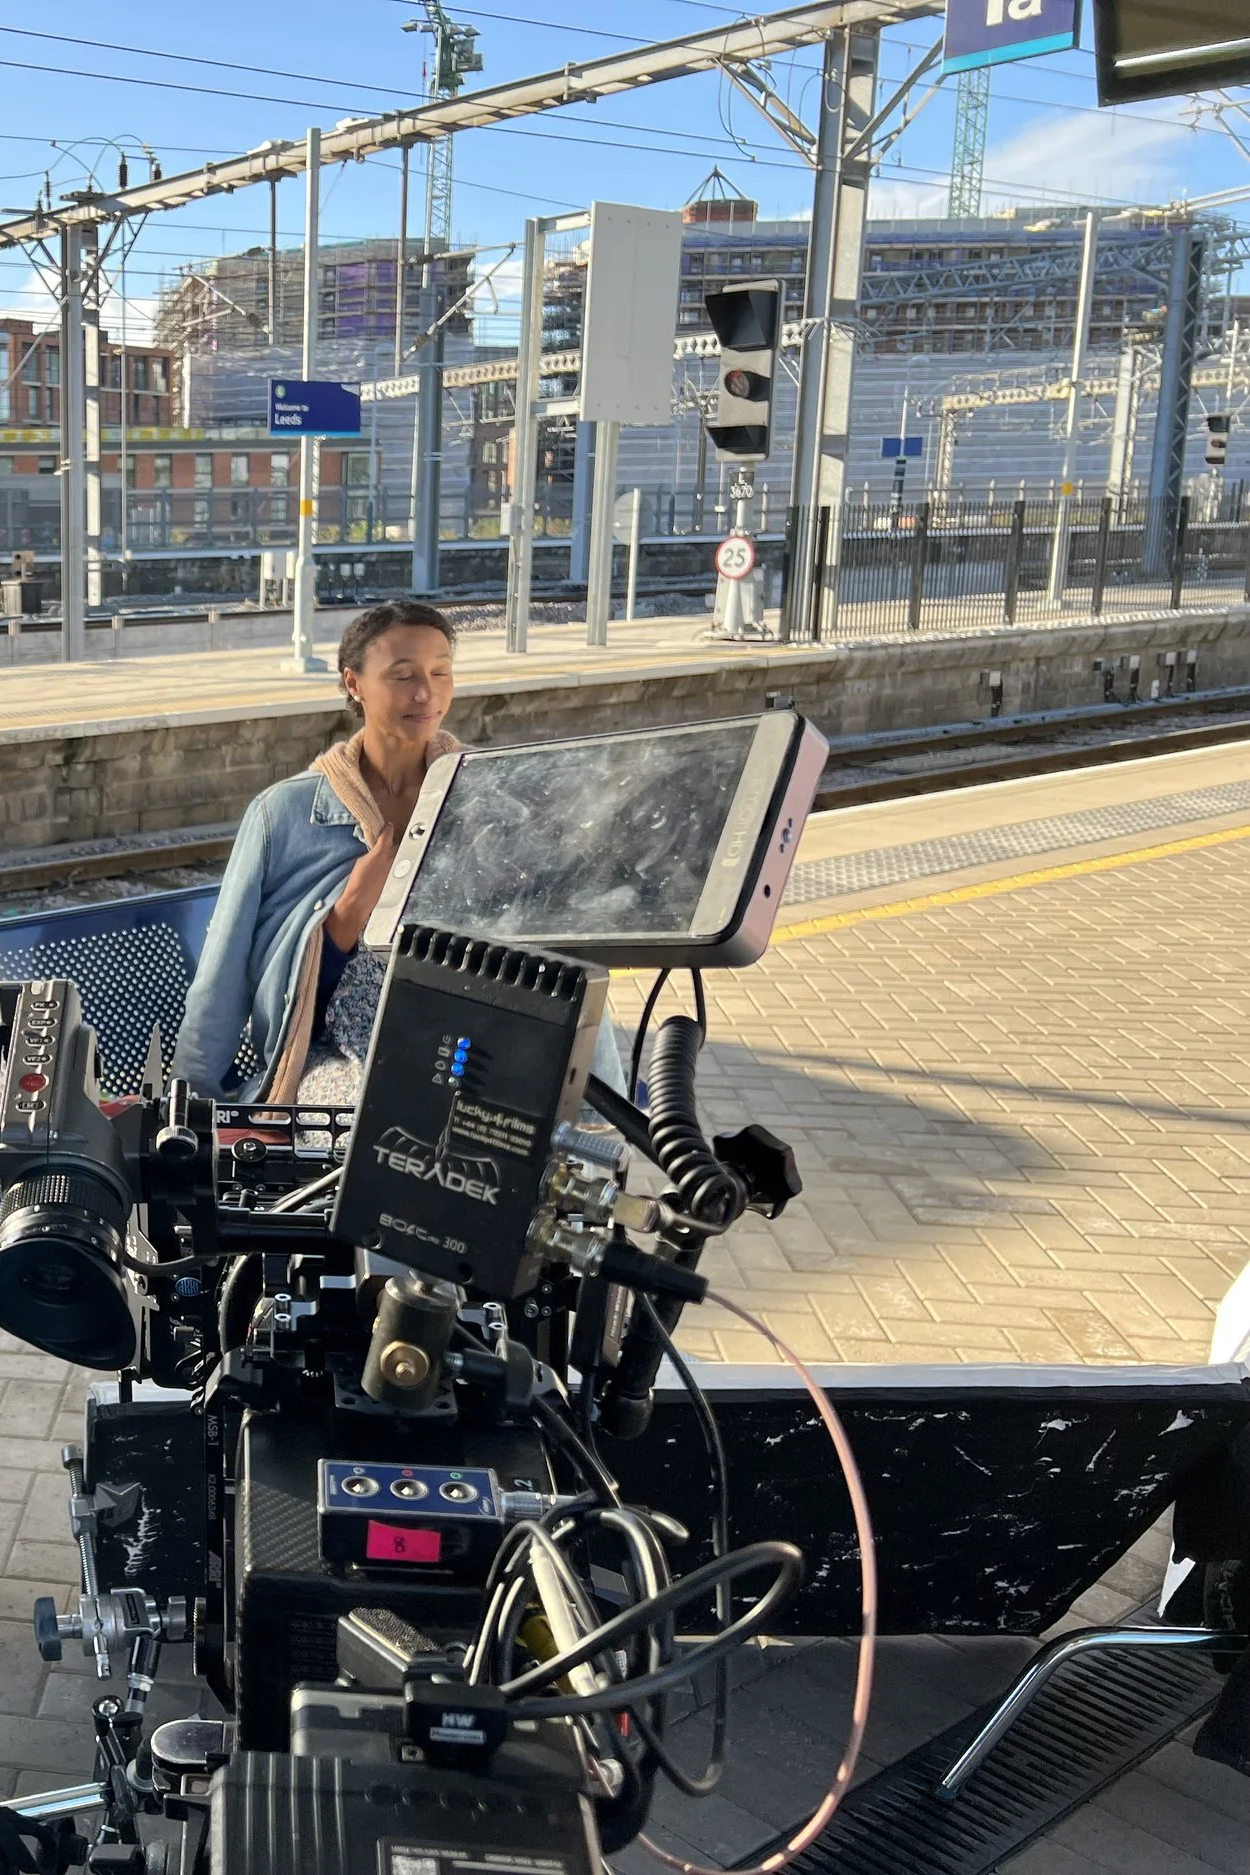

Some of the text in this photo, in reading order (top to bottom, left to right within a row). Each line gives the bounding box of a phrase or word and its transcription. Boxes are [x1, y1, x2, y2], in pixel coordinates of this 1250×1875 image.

[275, 403, 310, 412] Welcome to
[274, 413, 302, 425] Leeds
[723, 548, 746, 568] 25
[216, 1110, 231, 1124] RI
[373, 1145, 500, 1205] TERADEK
[442, 1236, 467, 1254] 300
[207, 1414, 219, 1446] MSB-1
[208, 1550, 222, 1586] ARRI
